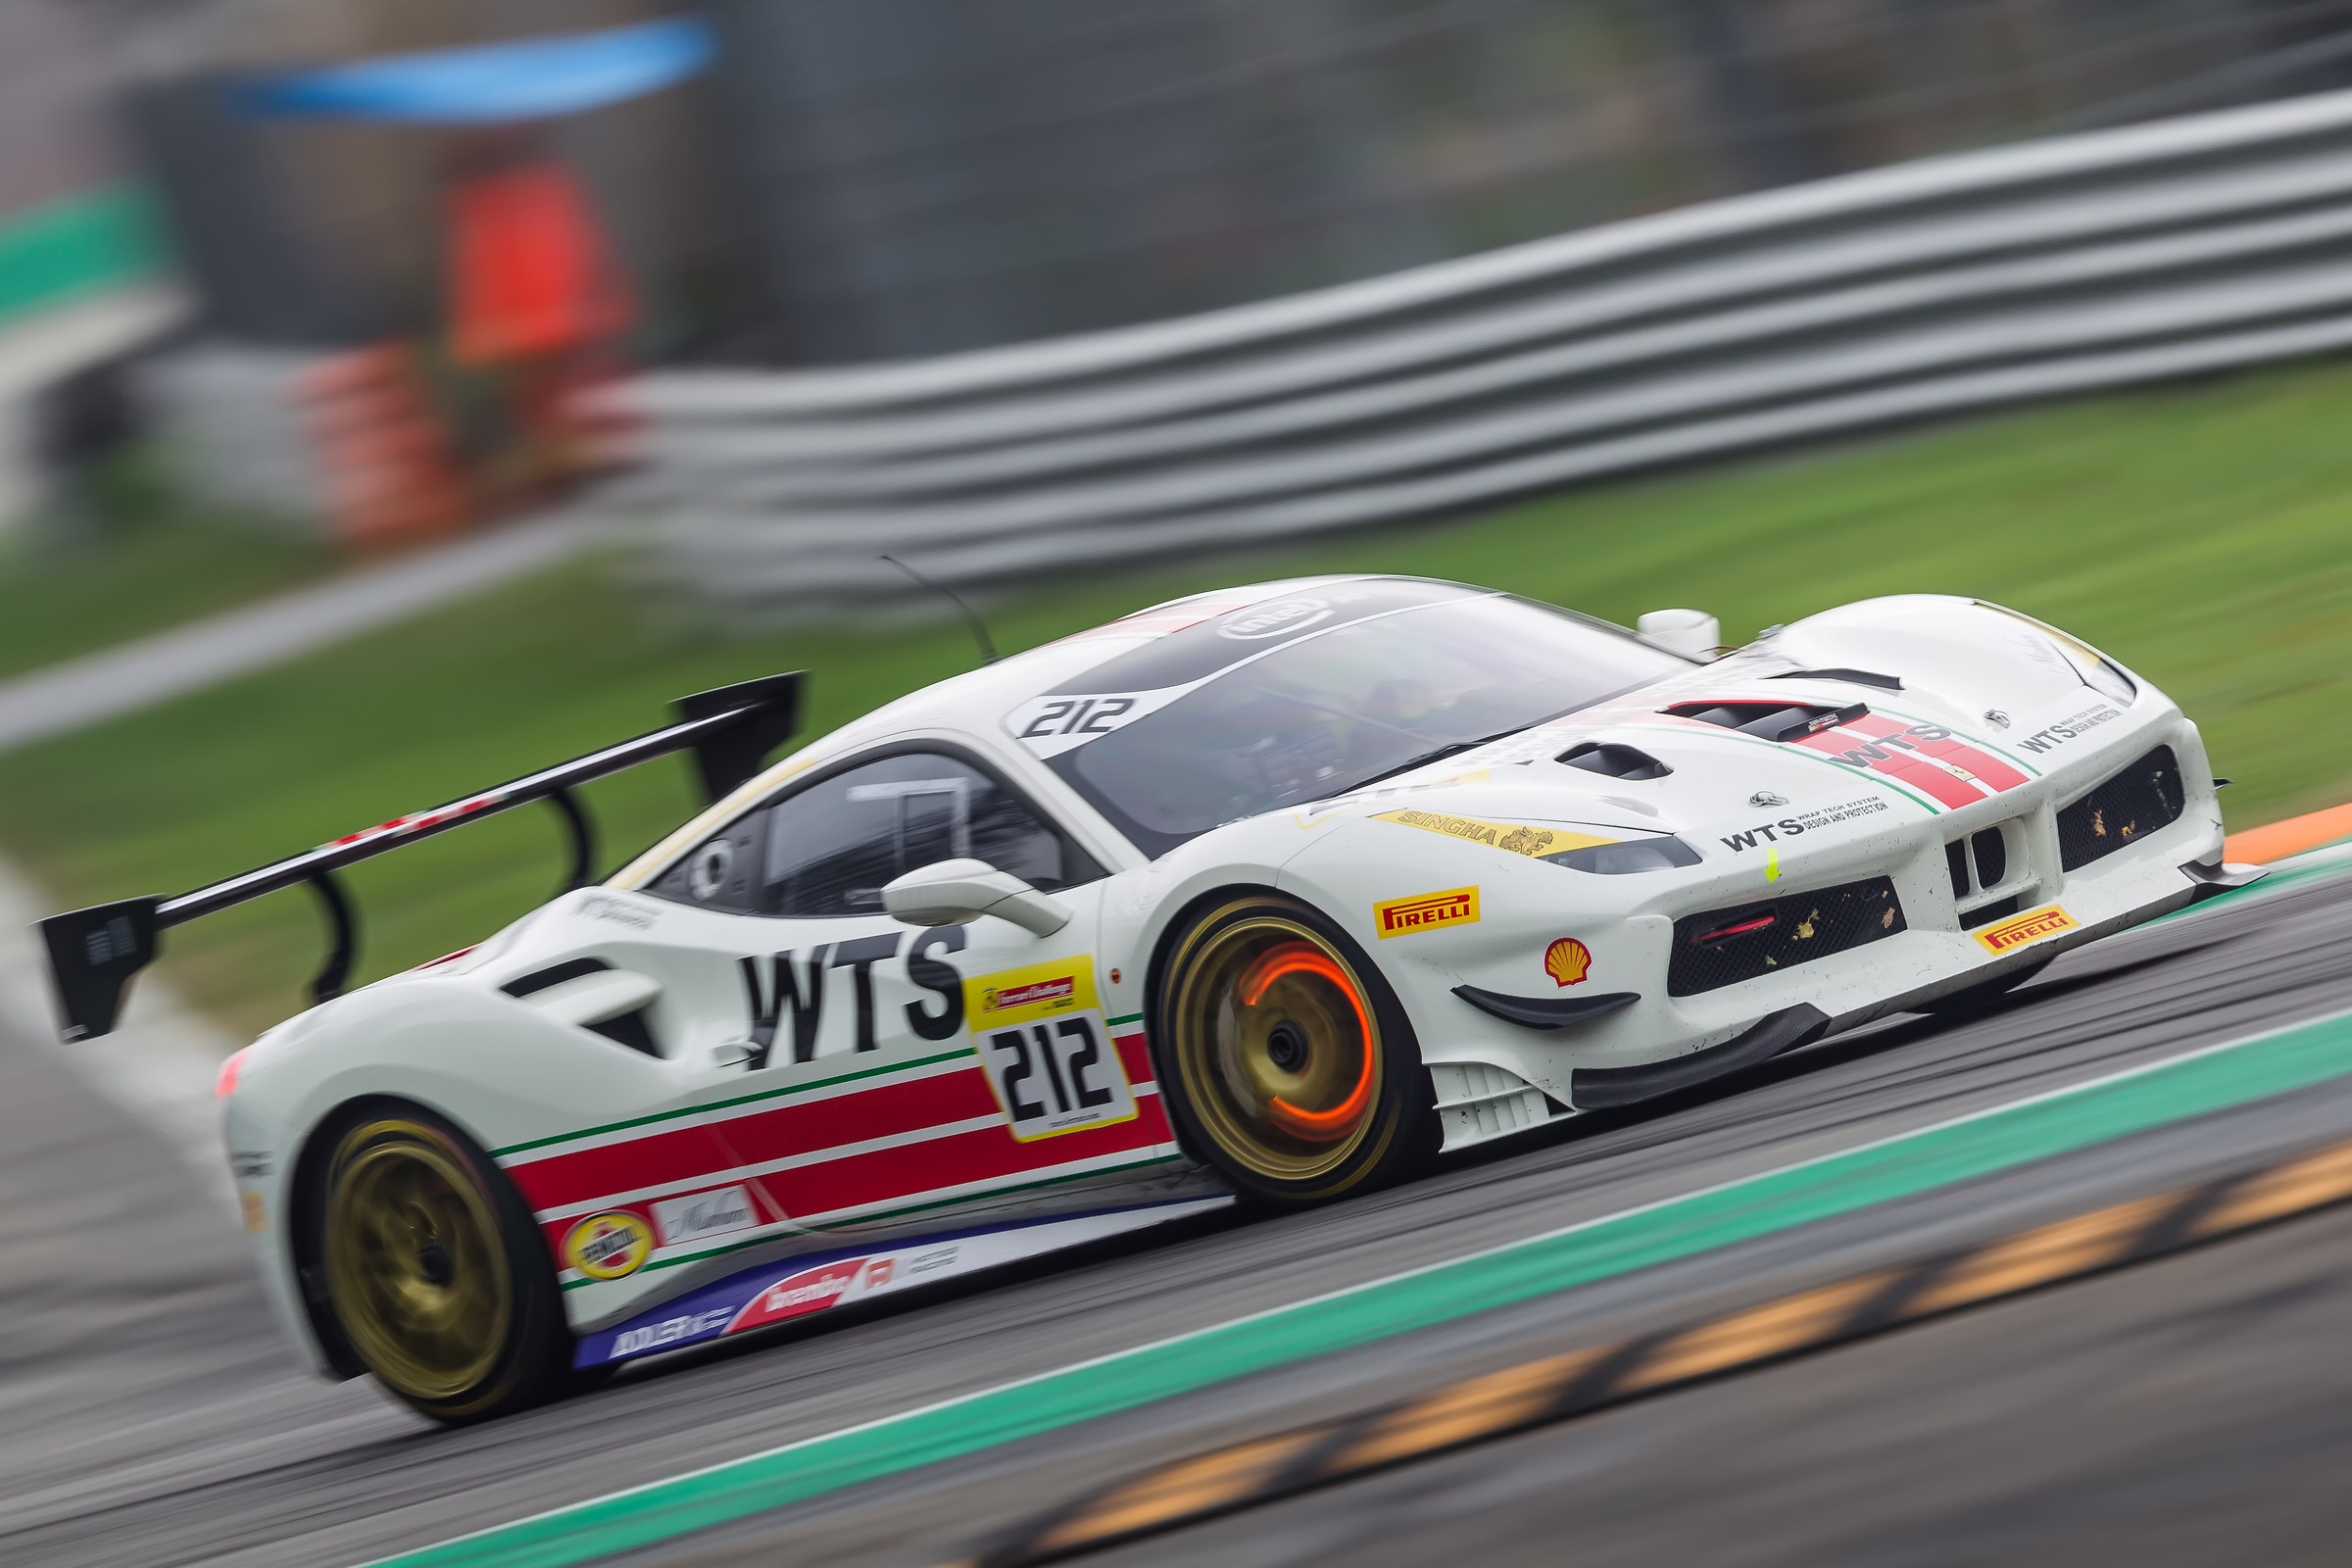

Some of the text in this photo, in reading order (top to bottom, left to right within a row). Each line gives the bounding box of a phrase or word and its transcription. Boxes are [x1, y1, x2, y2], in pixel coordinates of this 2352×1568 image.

[1015, 698, 1137, 739] 212
[1827, 724, 1950, 768] WTS
[2016, 724, 2077, 754] WTS
[1397, 810, 1497, 844] SINGHA
[1796, 796, 1881, 820] WRAP TECH SYSTEM
[1803, 801, 1889, 830] DESIGN AND PROTECTION
[1720, 818, 1805, 853] WTS
[1382, 893, 1470, 931] PIRELLI
[1984, 910, 2069, 950] PIRELLI
[738, 926, 967, 1072] WTS
[990, 1016, 1113, 1122] 212
[765, 1273, 850, 1313] brembo
